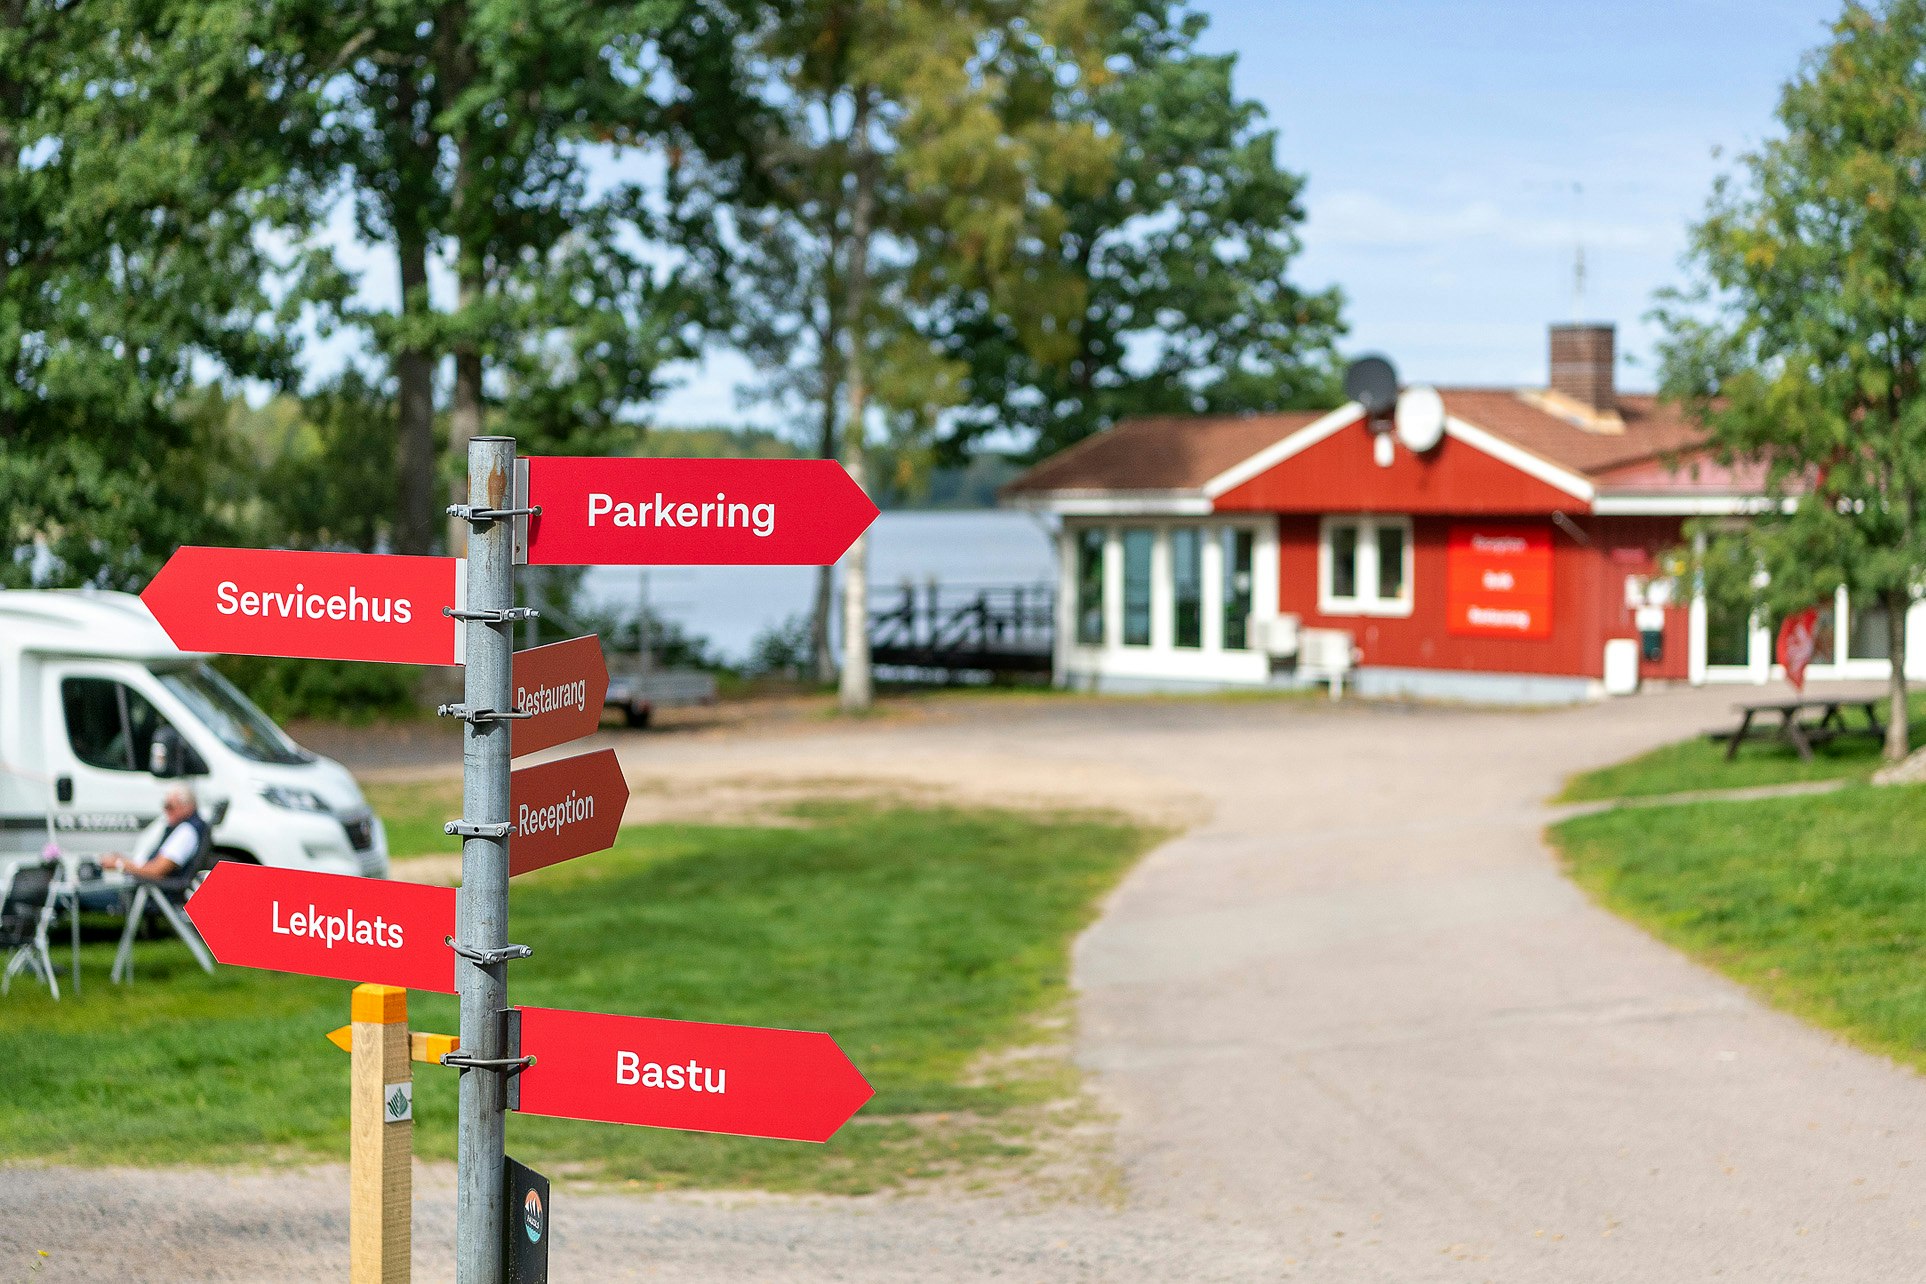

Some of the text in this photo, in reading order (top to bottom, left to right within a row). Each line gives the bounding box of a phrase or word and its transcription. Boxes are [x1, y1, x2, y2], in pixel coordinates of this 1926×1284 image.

[588, 491, 775, 538] Parkering
[216, 581, 413, 625] Servicehus
[517, 678, 585, 715] Restaurang
[519, 789, 594, 837] Reception
[271, 899, 405, 950] Lekplats
[616, 1050, 727, 1094] Bastu
